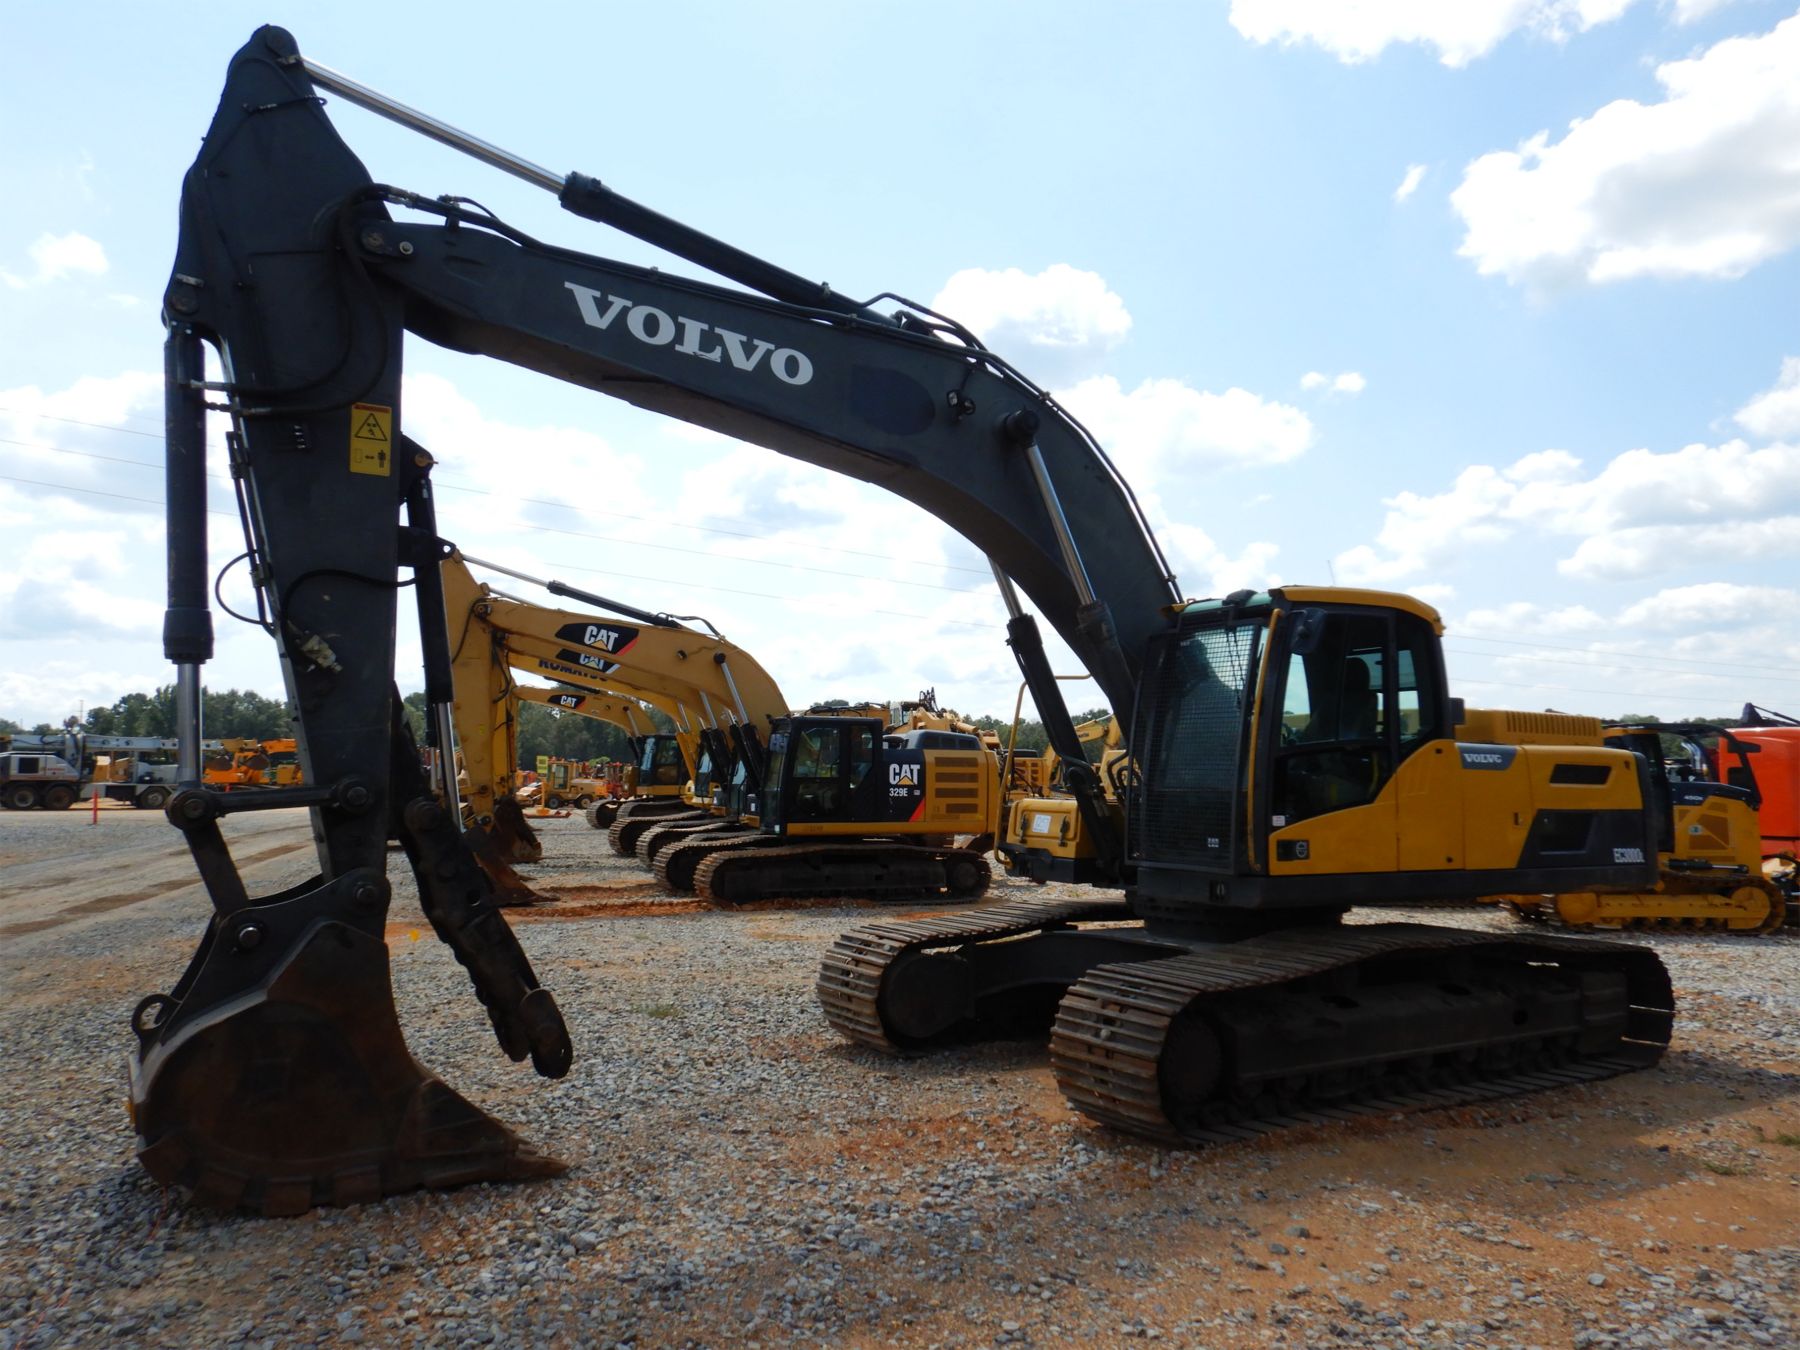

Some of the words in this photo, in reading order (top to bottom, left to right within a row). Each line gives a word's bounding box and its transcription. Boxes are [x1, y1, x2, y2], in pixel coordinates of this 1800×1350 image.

[564, 281, 813, 385] VOLVO
[584, 625, 618, 651] CAT
[560, 695, 577, 708] CAT
[889, 763, 920, 785] CAT
[889, 787, 908, 797] 329E
